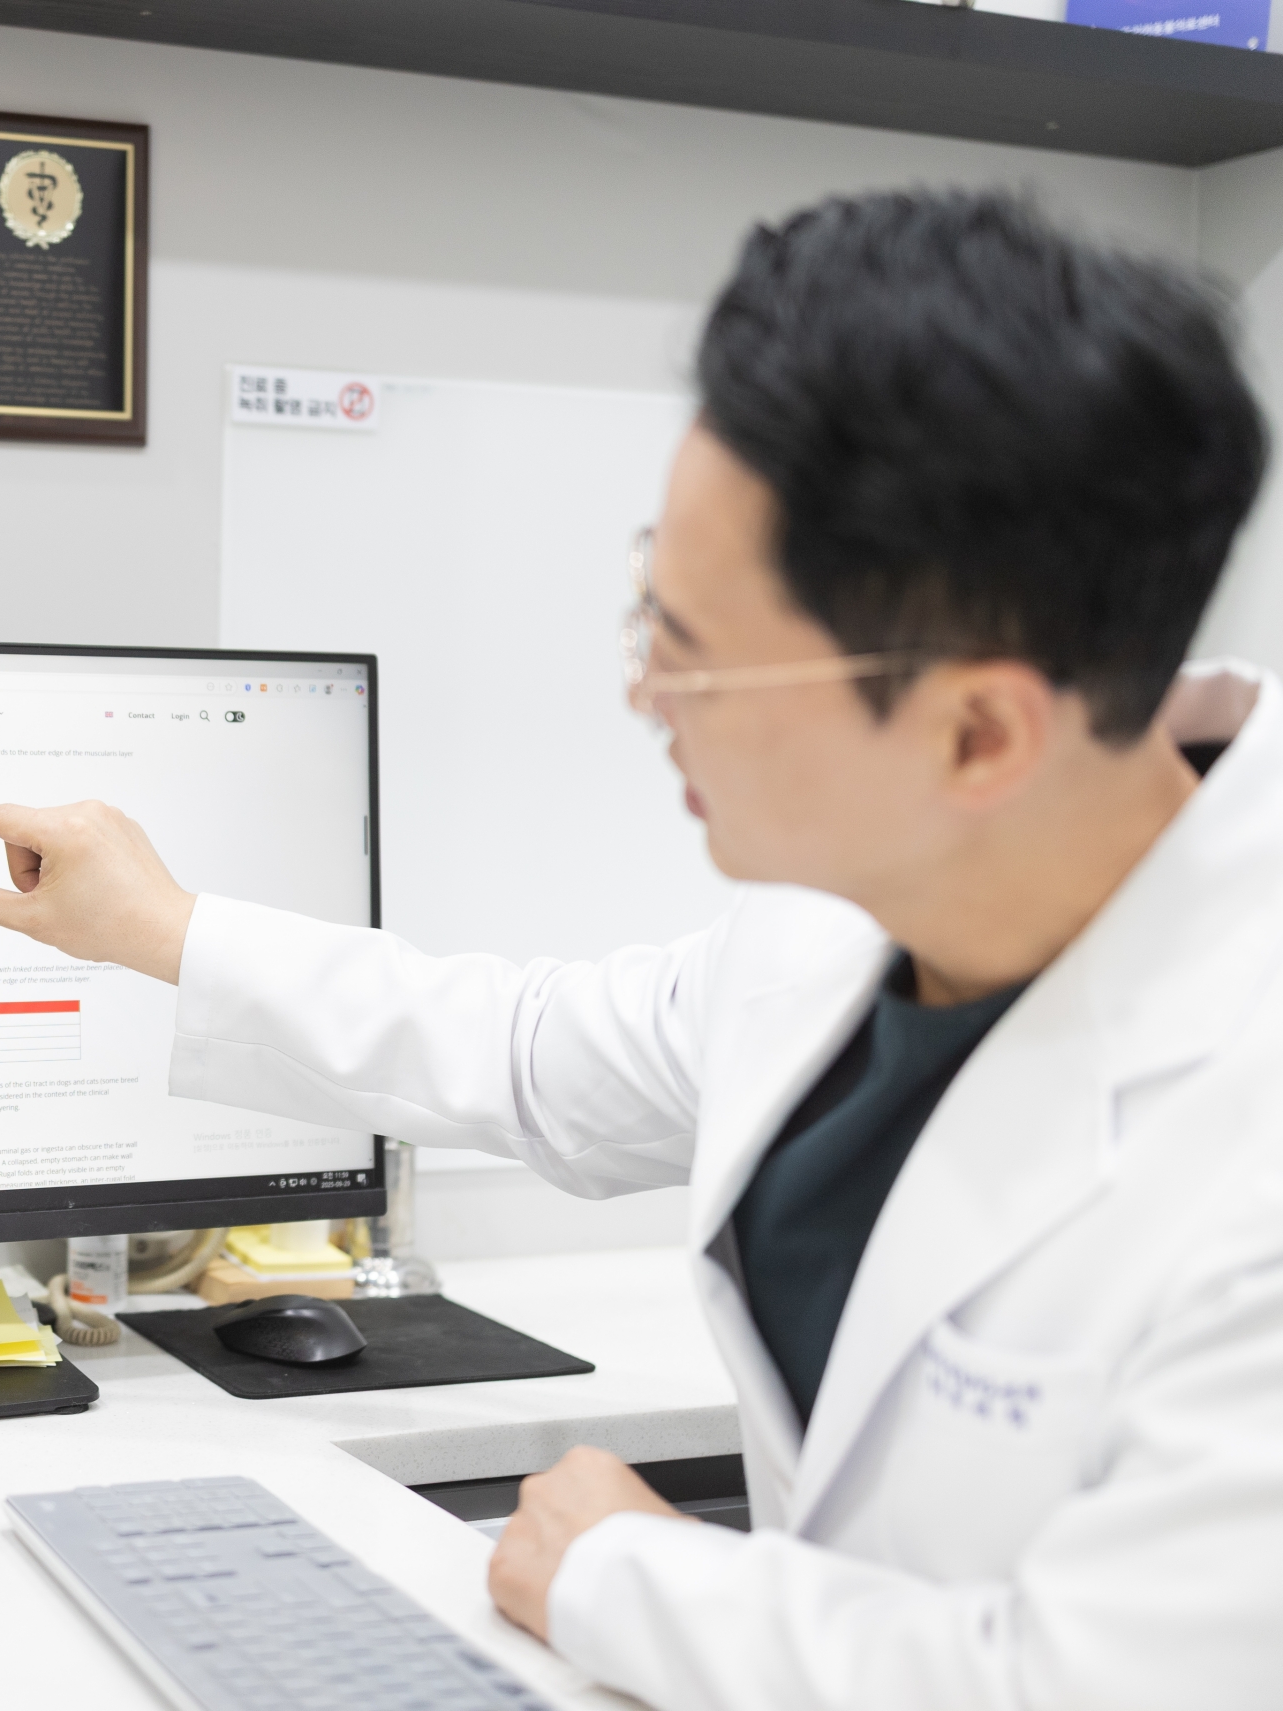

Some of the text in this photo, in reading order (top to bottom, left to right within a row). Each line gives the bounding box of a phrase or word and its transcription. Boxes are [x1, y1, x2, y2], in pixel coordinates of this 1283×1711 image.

[128, 711, 156, 719] Contact
[171, 712, 190, 721] Login
[48, 749, 63, 758] edge
[118, 750, 133, 759] layer
[56, 1079, 71, 1088] dogs
[193, 1132, 232, 1141] Windows
[20, 1147, 31, 1156] gas
[40, 1145, 64, 1154] ingesta
